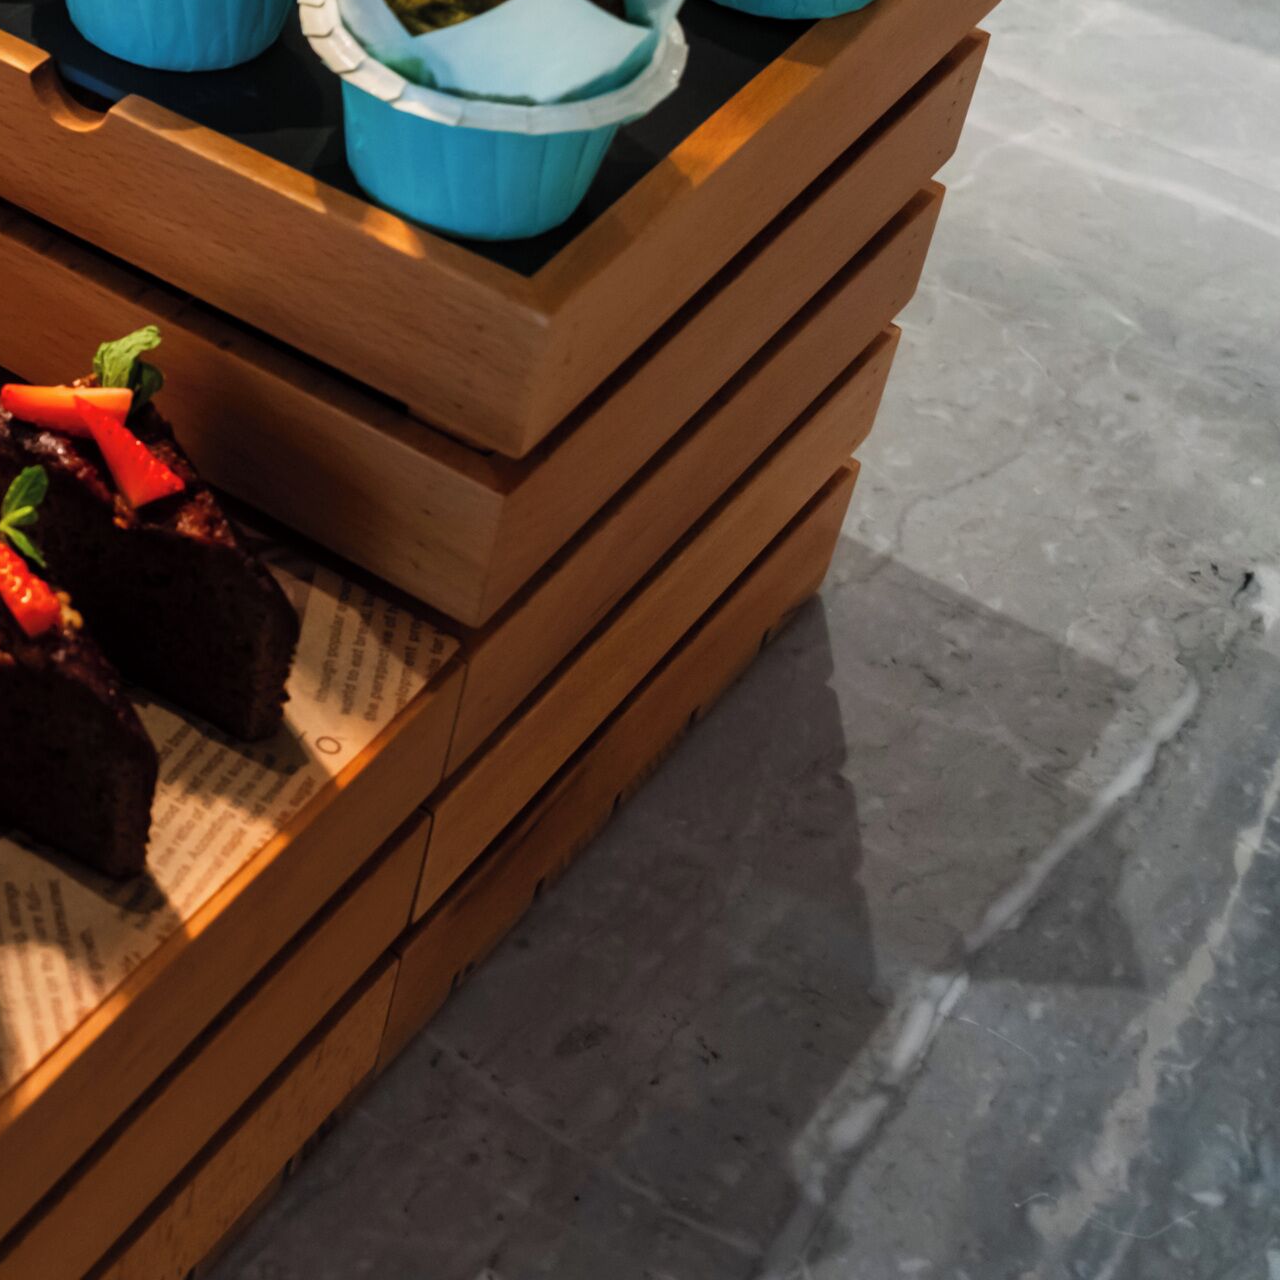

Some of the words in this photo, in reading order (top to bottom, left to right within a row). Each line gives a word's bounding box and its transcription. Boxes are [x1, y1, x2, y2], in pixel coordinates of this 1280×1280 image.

[348, 647, 364, 668] eat
[345, 668, 359, 682] to
[361, 701, 379, 722] the
